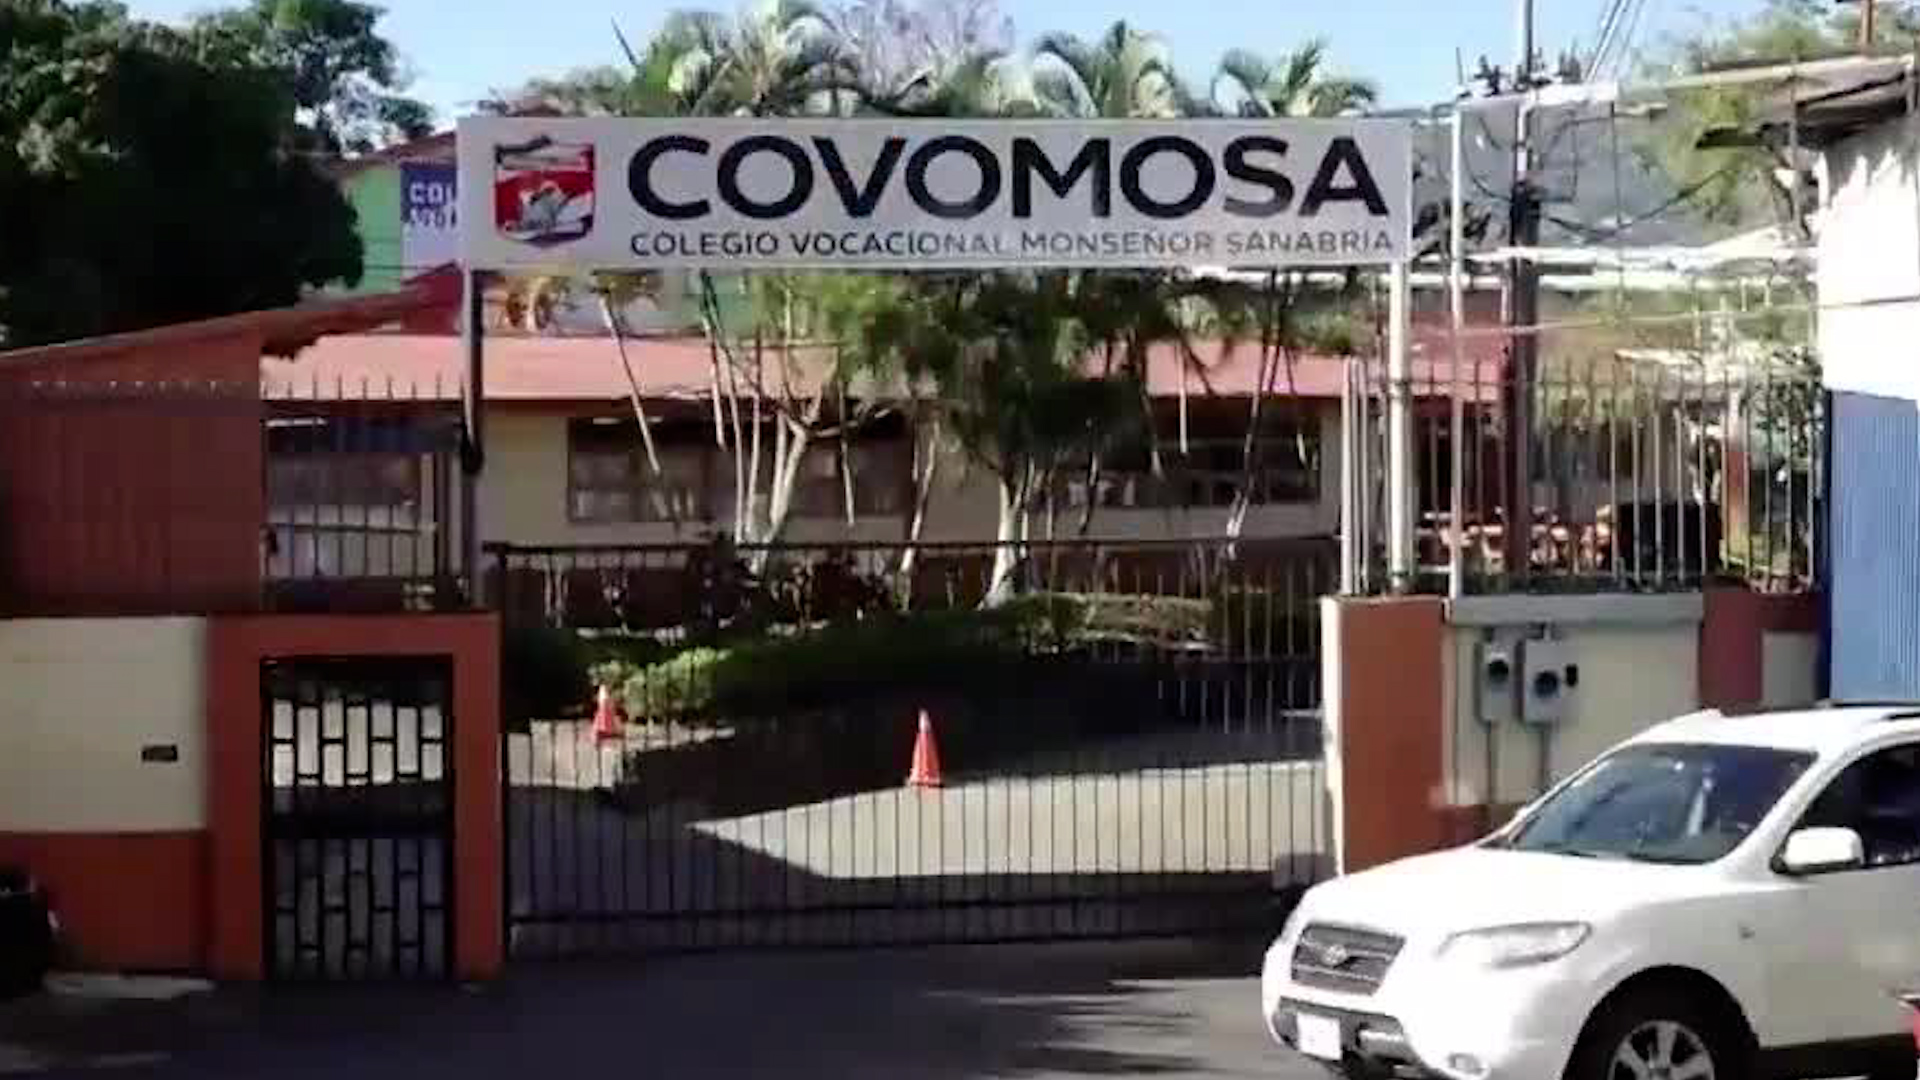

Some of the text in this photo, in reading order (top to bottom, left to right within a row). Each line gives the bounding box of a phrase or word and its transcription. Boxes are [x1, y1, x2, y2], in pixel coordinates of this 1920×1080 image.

[628, 134, 1389, 220] COVOMOSA
[631, 231, 779, 257] COLEGIO
[789, 231, 1014, 256] VOCACIONAL
[1226, 230, 1393, 255] SANABRIA
